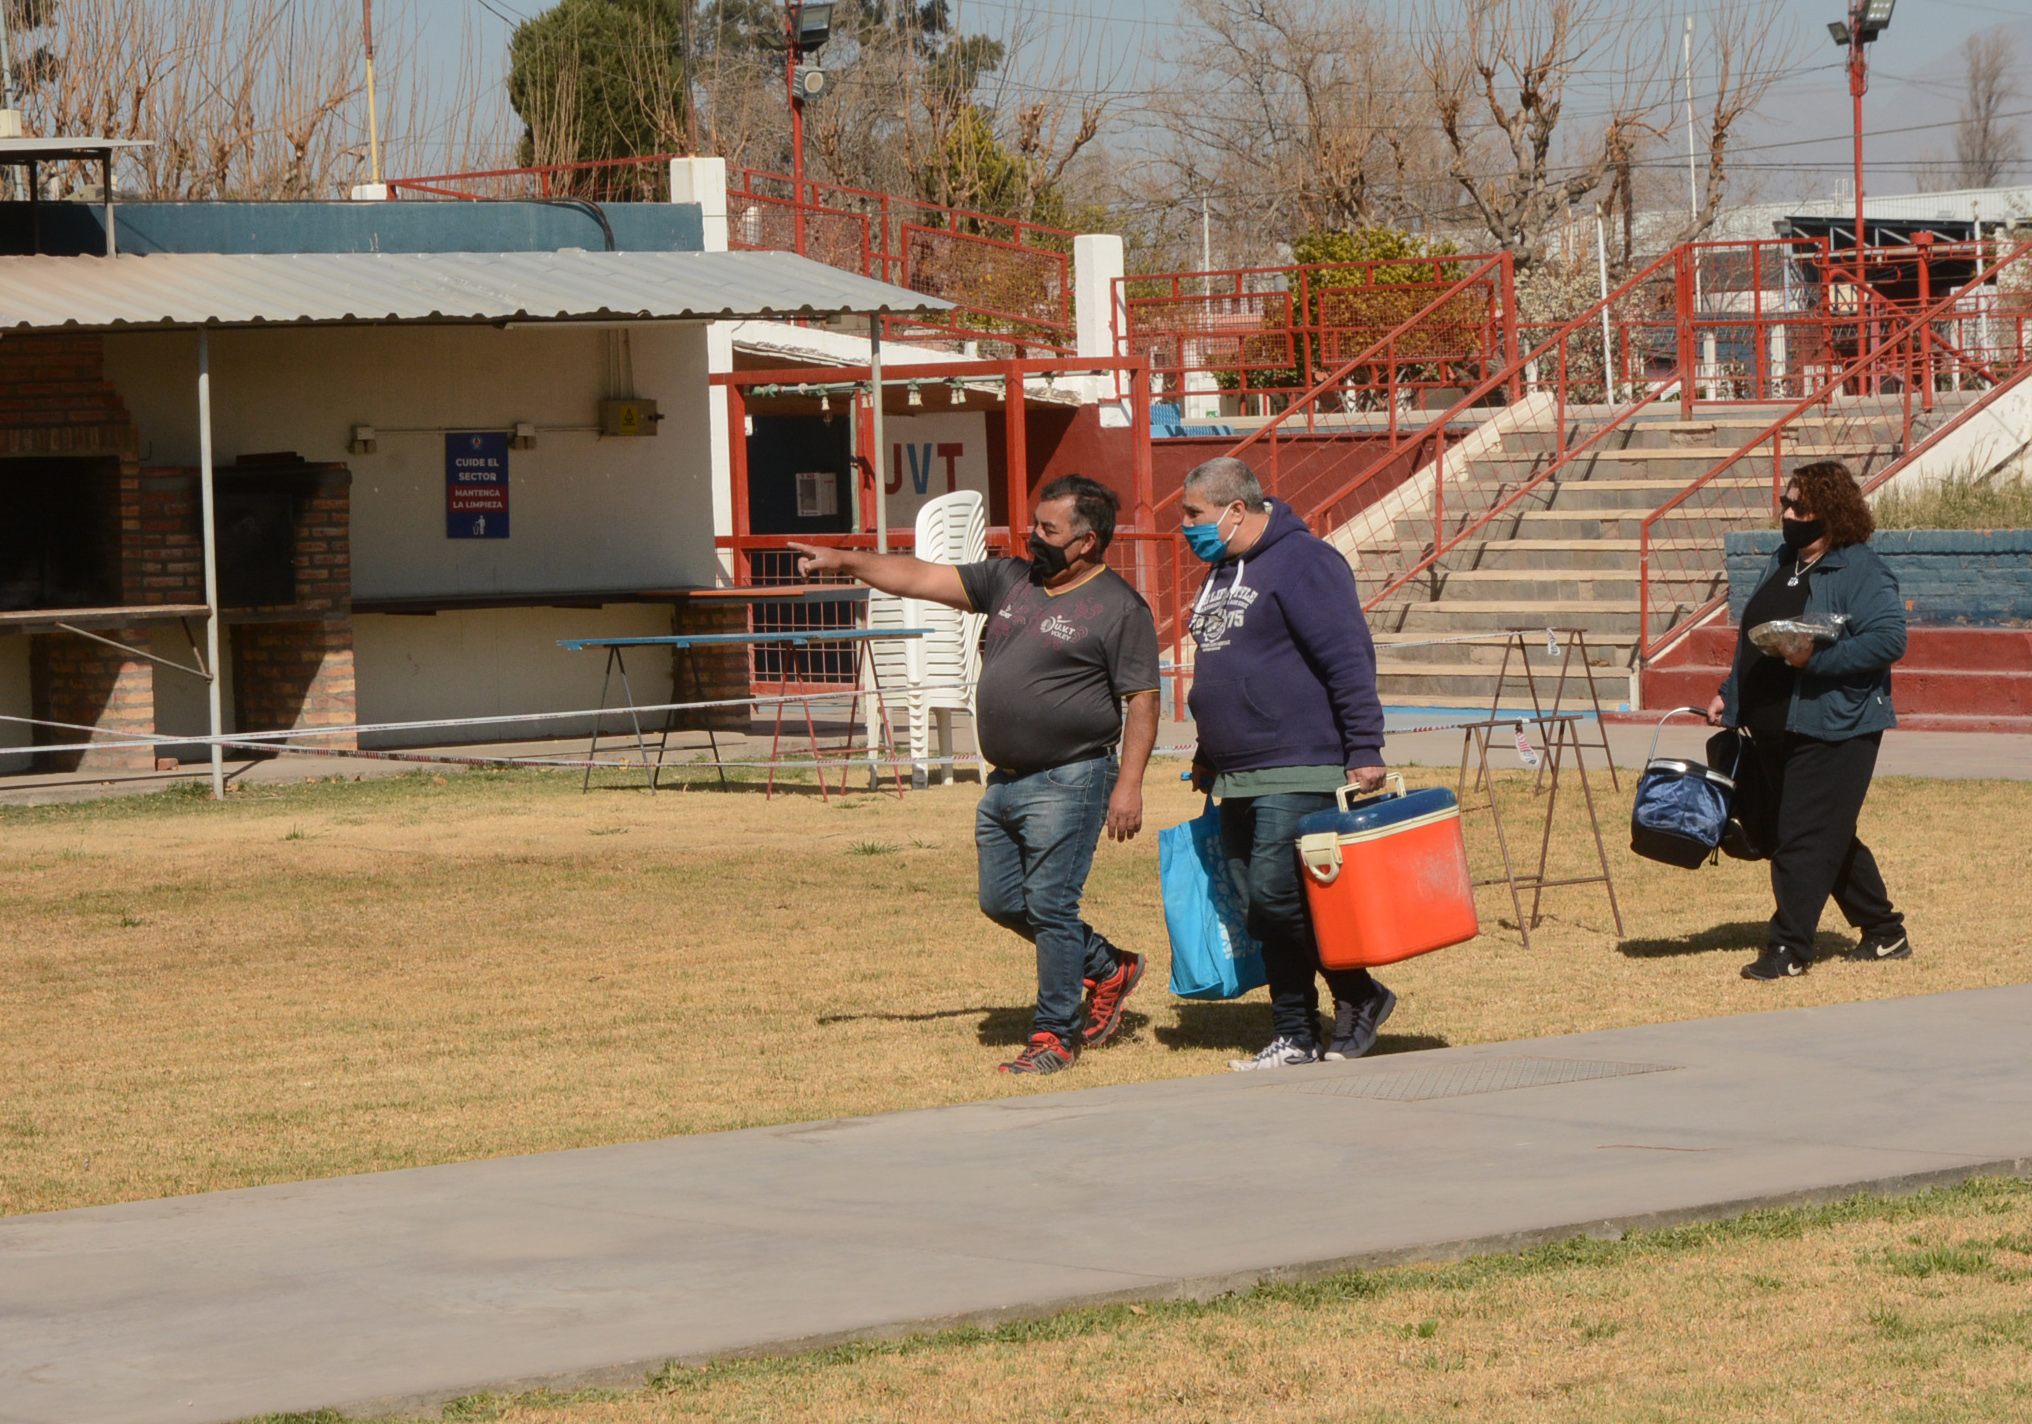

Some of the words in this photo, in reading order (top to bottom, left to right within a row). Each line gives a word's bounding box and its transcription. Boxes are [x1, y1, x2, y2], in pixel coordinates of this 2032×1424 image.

[455, 458, 485, 467] CUIDE
[488, 458, 499, 467] EL
[458, 472, 497, 482] SECTOR
[452, 501, 464, 509] LA
[465, 501, 503, 509] LIMPIEZA
[1050, 629, 1072, 642] VOLEY
